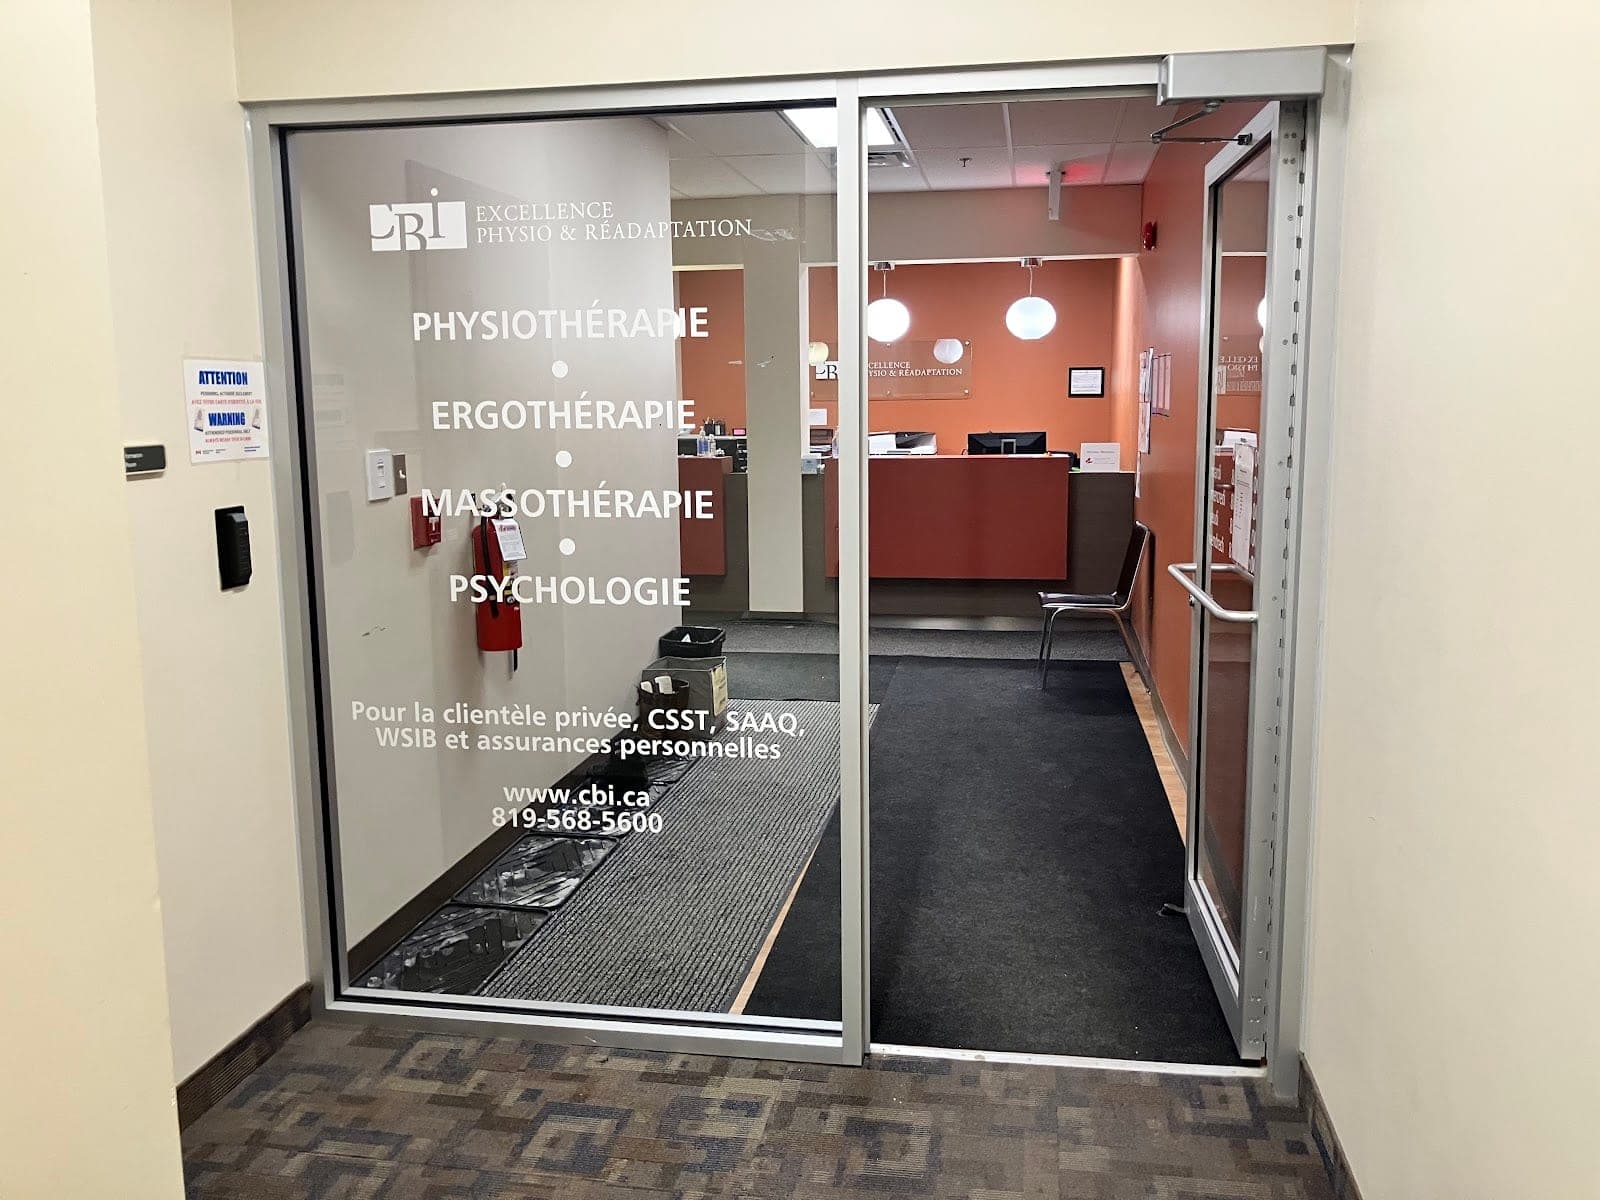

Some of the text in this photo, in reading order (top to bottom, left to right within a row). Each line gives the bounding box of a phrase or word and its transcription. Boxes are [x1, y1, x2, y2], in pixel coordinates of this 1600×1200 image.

[475, 200, 614, 222] EXCELLENCE
[476, 217, 752, 244] PHYSIO & RÉADAPTATION
[412, 299, 709, 341] PHYSIOTHÉRAPIE
[198, 370, 248, 386] ATTENTION
[868, 361, 911, 369] CELLENCE
[868, 369, 887, 378] YSIO
[208, 411, 246, 427] WARNING
[432, 391, 696, 431] ERGOTHÉRAPIE
[421, 481, 714, 519] MASSOTHÉRAPIE
[450, 575, 691, 607] PSYCHOLOGIE
[351, 700, 805, 737] Pour la clientèle privée, CSST, SAAQ,
[375, 727, 782, 760] WSIB et assurances personnelles
[503, 783, 650, 808] www.cbi.ca
[492, 806, 663, 834] 819-568-5600
